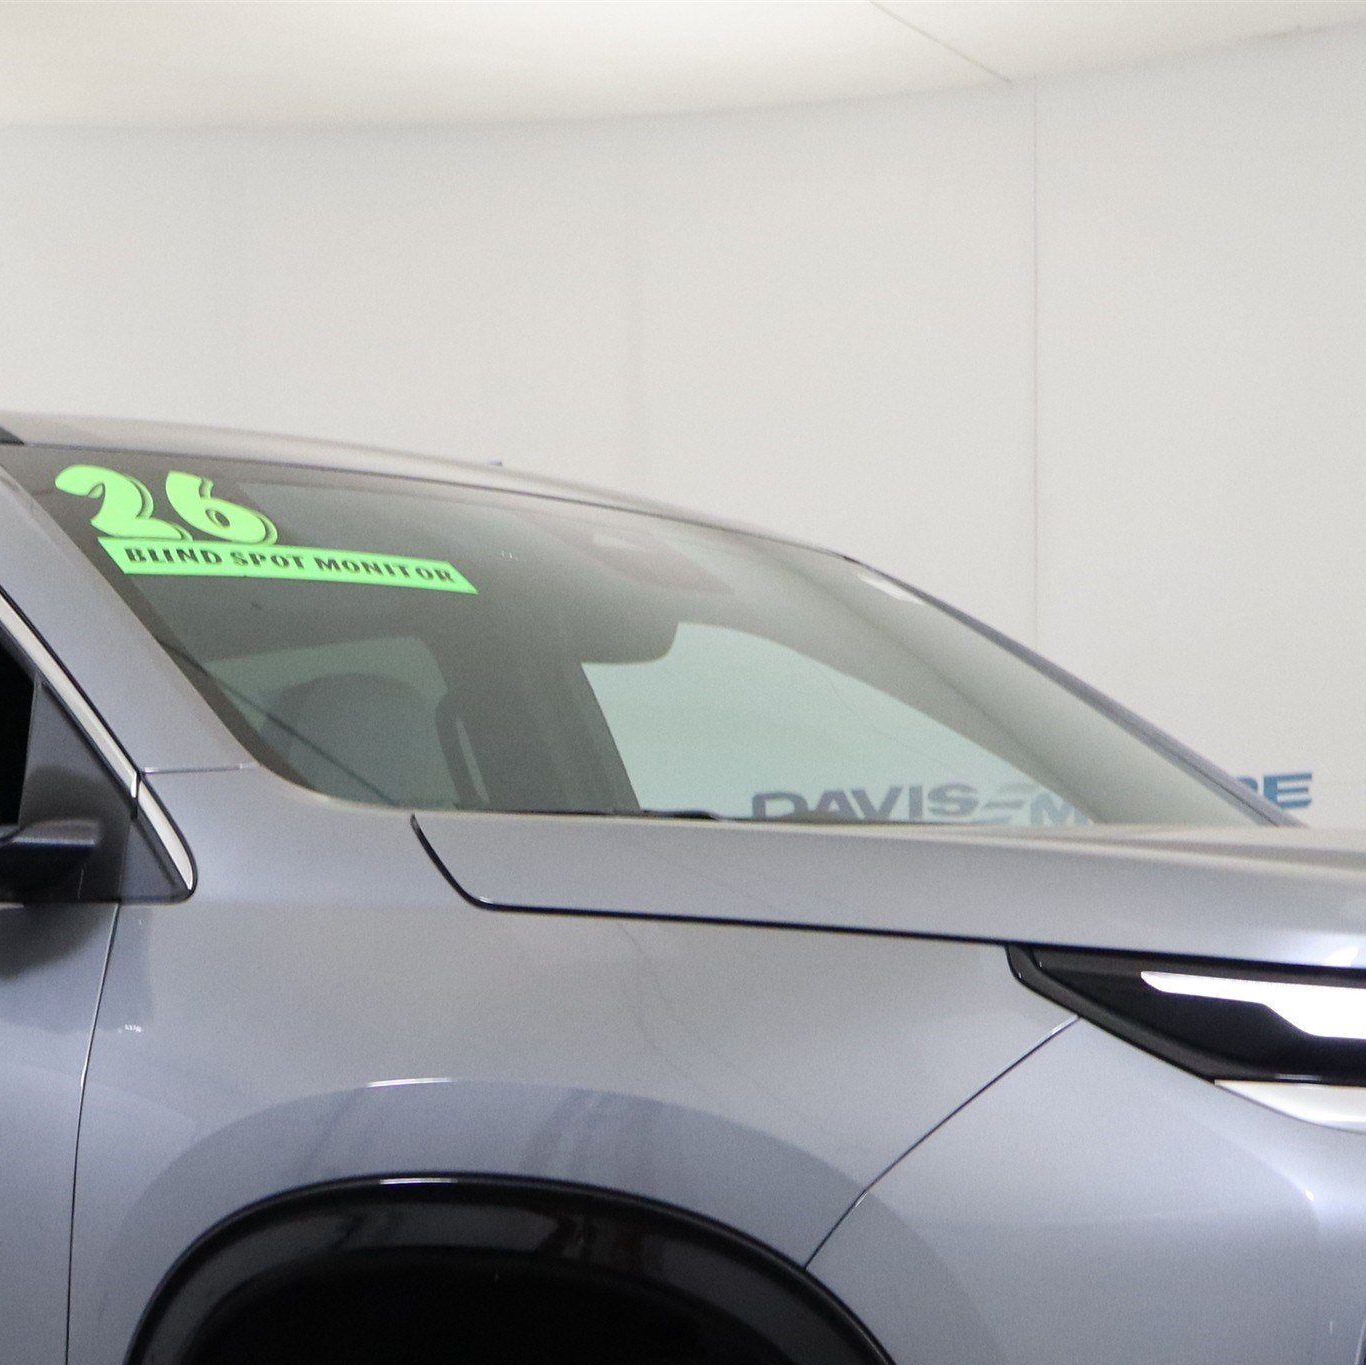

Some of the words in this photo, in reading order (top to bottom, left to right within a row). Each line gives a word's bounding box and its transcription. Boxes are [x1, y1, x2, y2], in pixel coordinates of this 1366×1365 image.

[55, 464, 278, 545] 26
[125, 547, 222, 566] BLIND
[230, 551, 306, 571] SPOT
[315, 557, 456, 582] MONITOR
